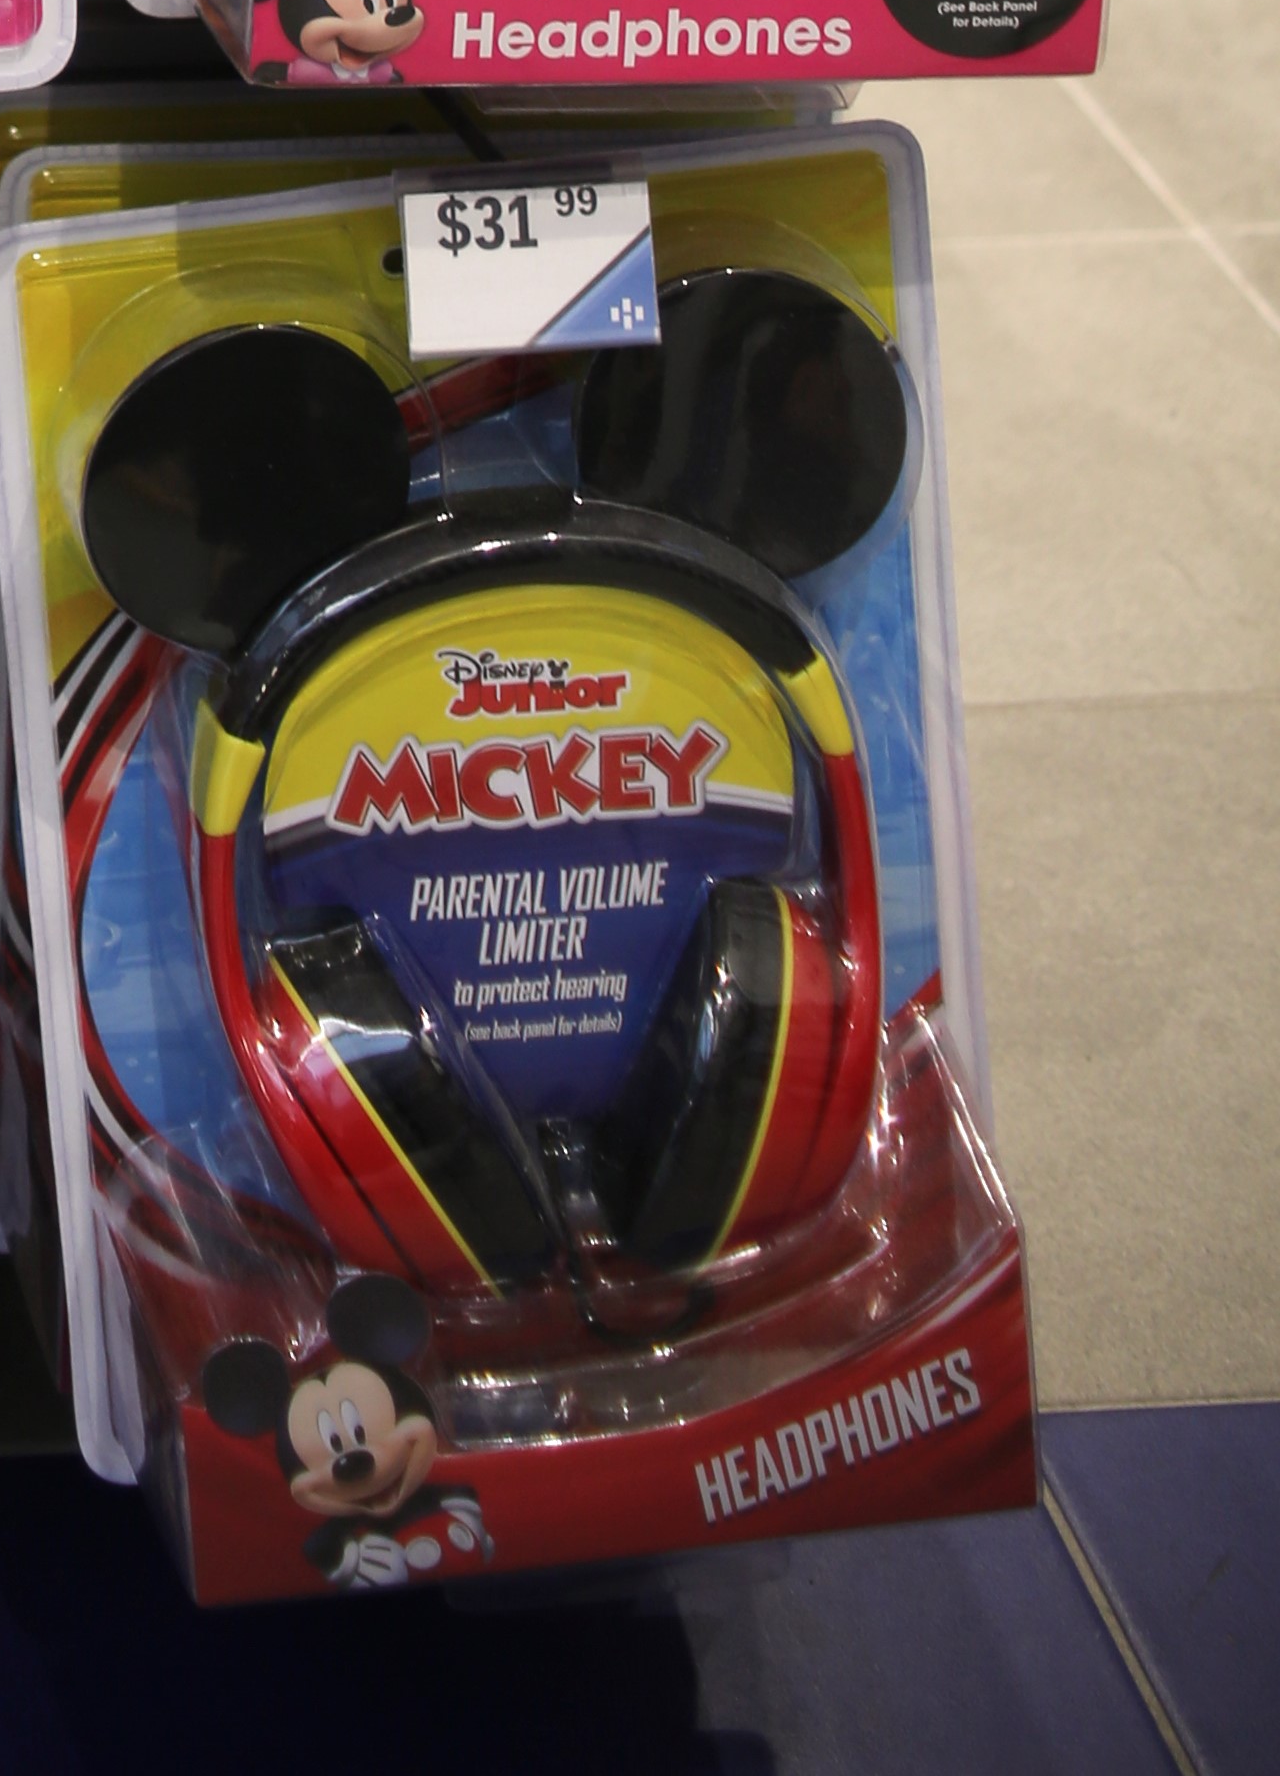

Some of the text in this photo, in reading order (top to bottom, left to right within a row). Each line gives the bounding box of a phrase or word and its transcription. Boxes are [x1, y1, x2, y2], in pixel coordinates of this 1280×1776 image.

[452, 11, 851, 66] Headphones
[437, 186, 598, 257] $31 99
[438, 651, 543, 682] Disney
[333, 725, 722, 830] MICKEY
[410, 861, 668, 922] PARENTAL VOLUME
[478, 915, 587, 966] LIMITER
[454, 970, 627, 1011] to protect hearing
[693, 1347, 983, 1524] HEADPHONES
